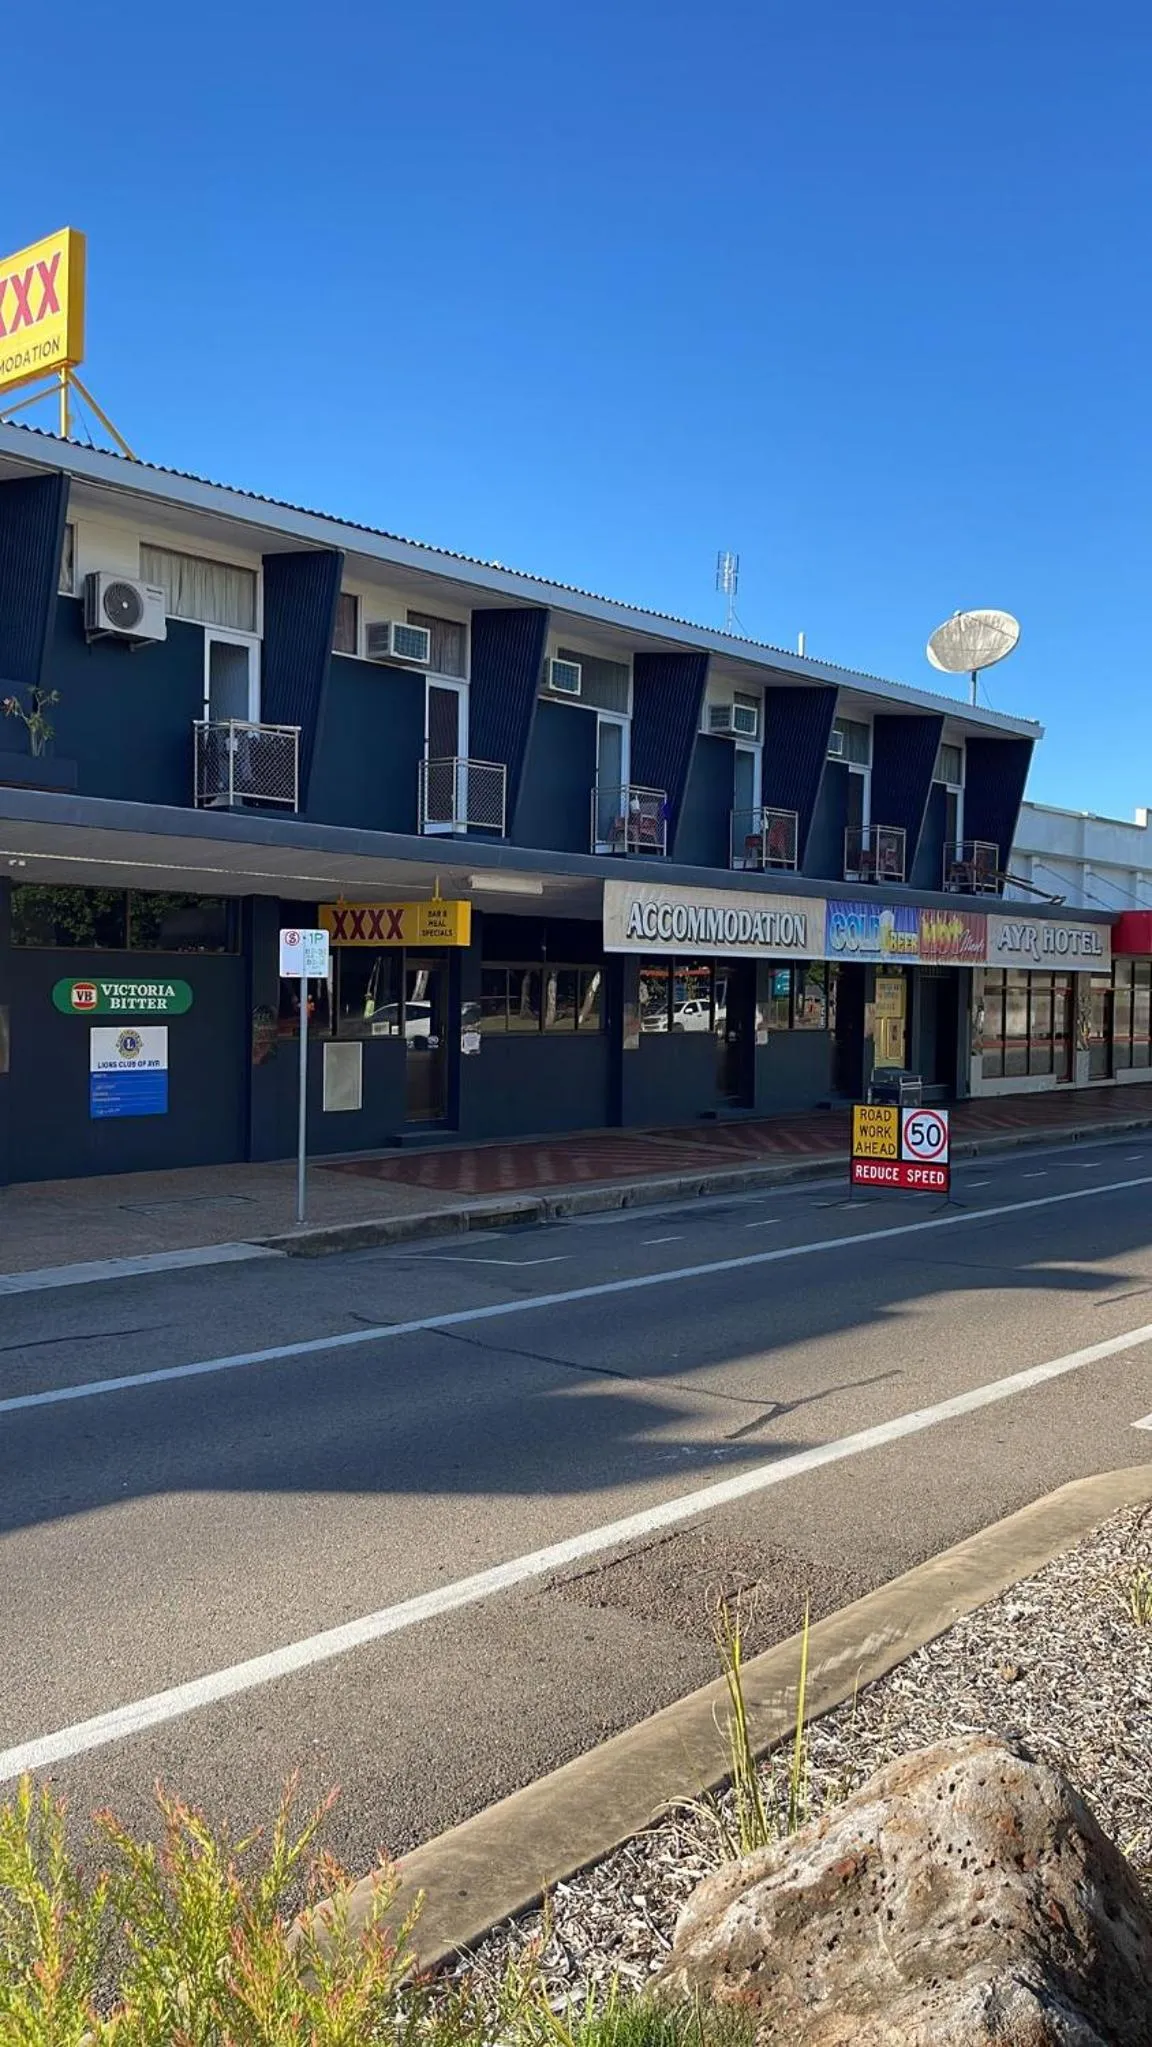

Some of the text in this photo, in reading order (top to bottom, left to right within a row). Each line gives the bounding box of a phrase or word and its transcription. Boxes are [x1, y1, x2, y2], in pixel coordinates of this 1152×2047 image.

[332, 909, 405, 940] XXXX
[627, 902, 808, 948] ACCOMMODATION
[831, 912, 880, 951] COLD
[310, 933, 323, 944] 1P
[422, 929, 453, 937] SPECIALS
[888, 931, 919, 954] BEER
[998, 924, 1103, 961] AYR HOTEL
[76, 990, 93, 1002] VB
[101, 983, 176, 997] VICTORIA
[110, 998, 168, 1009] BITTER
[98, 1061, 117, 1069] LIONS
[860, 1108, 892, 1122] ROAD
[860, 1125, 892, 1139] WORK
[911, 1122, 941, 1147] 50
[855, 1141, 896, 1156] AHEAD
[855, 1165, 945, 1185] REDUCE SPEED
